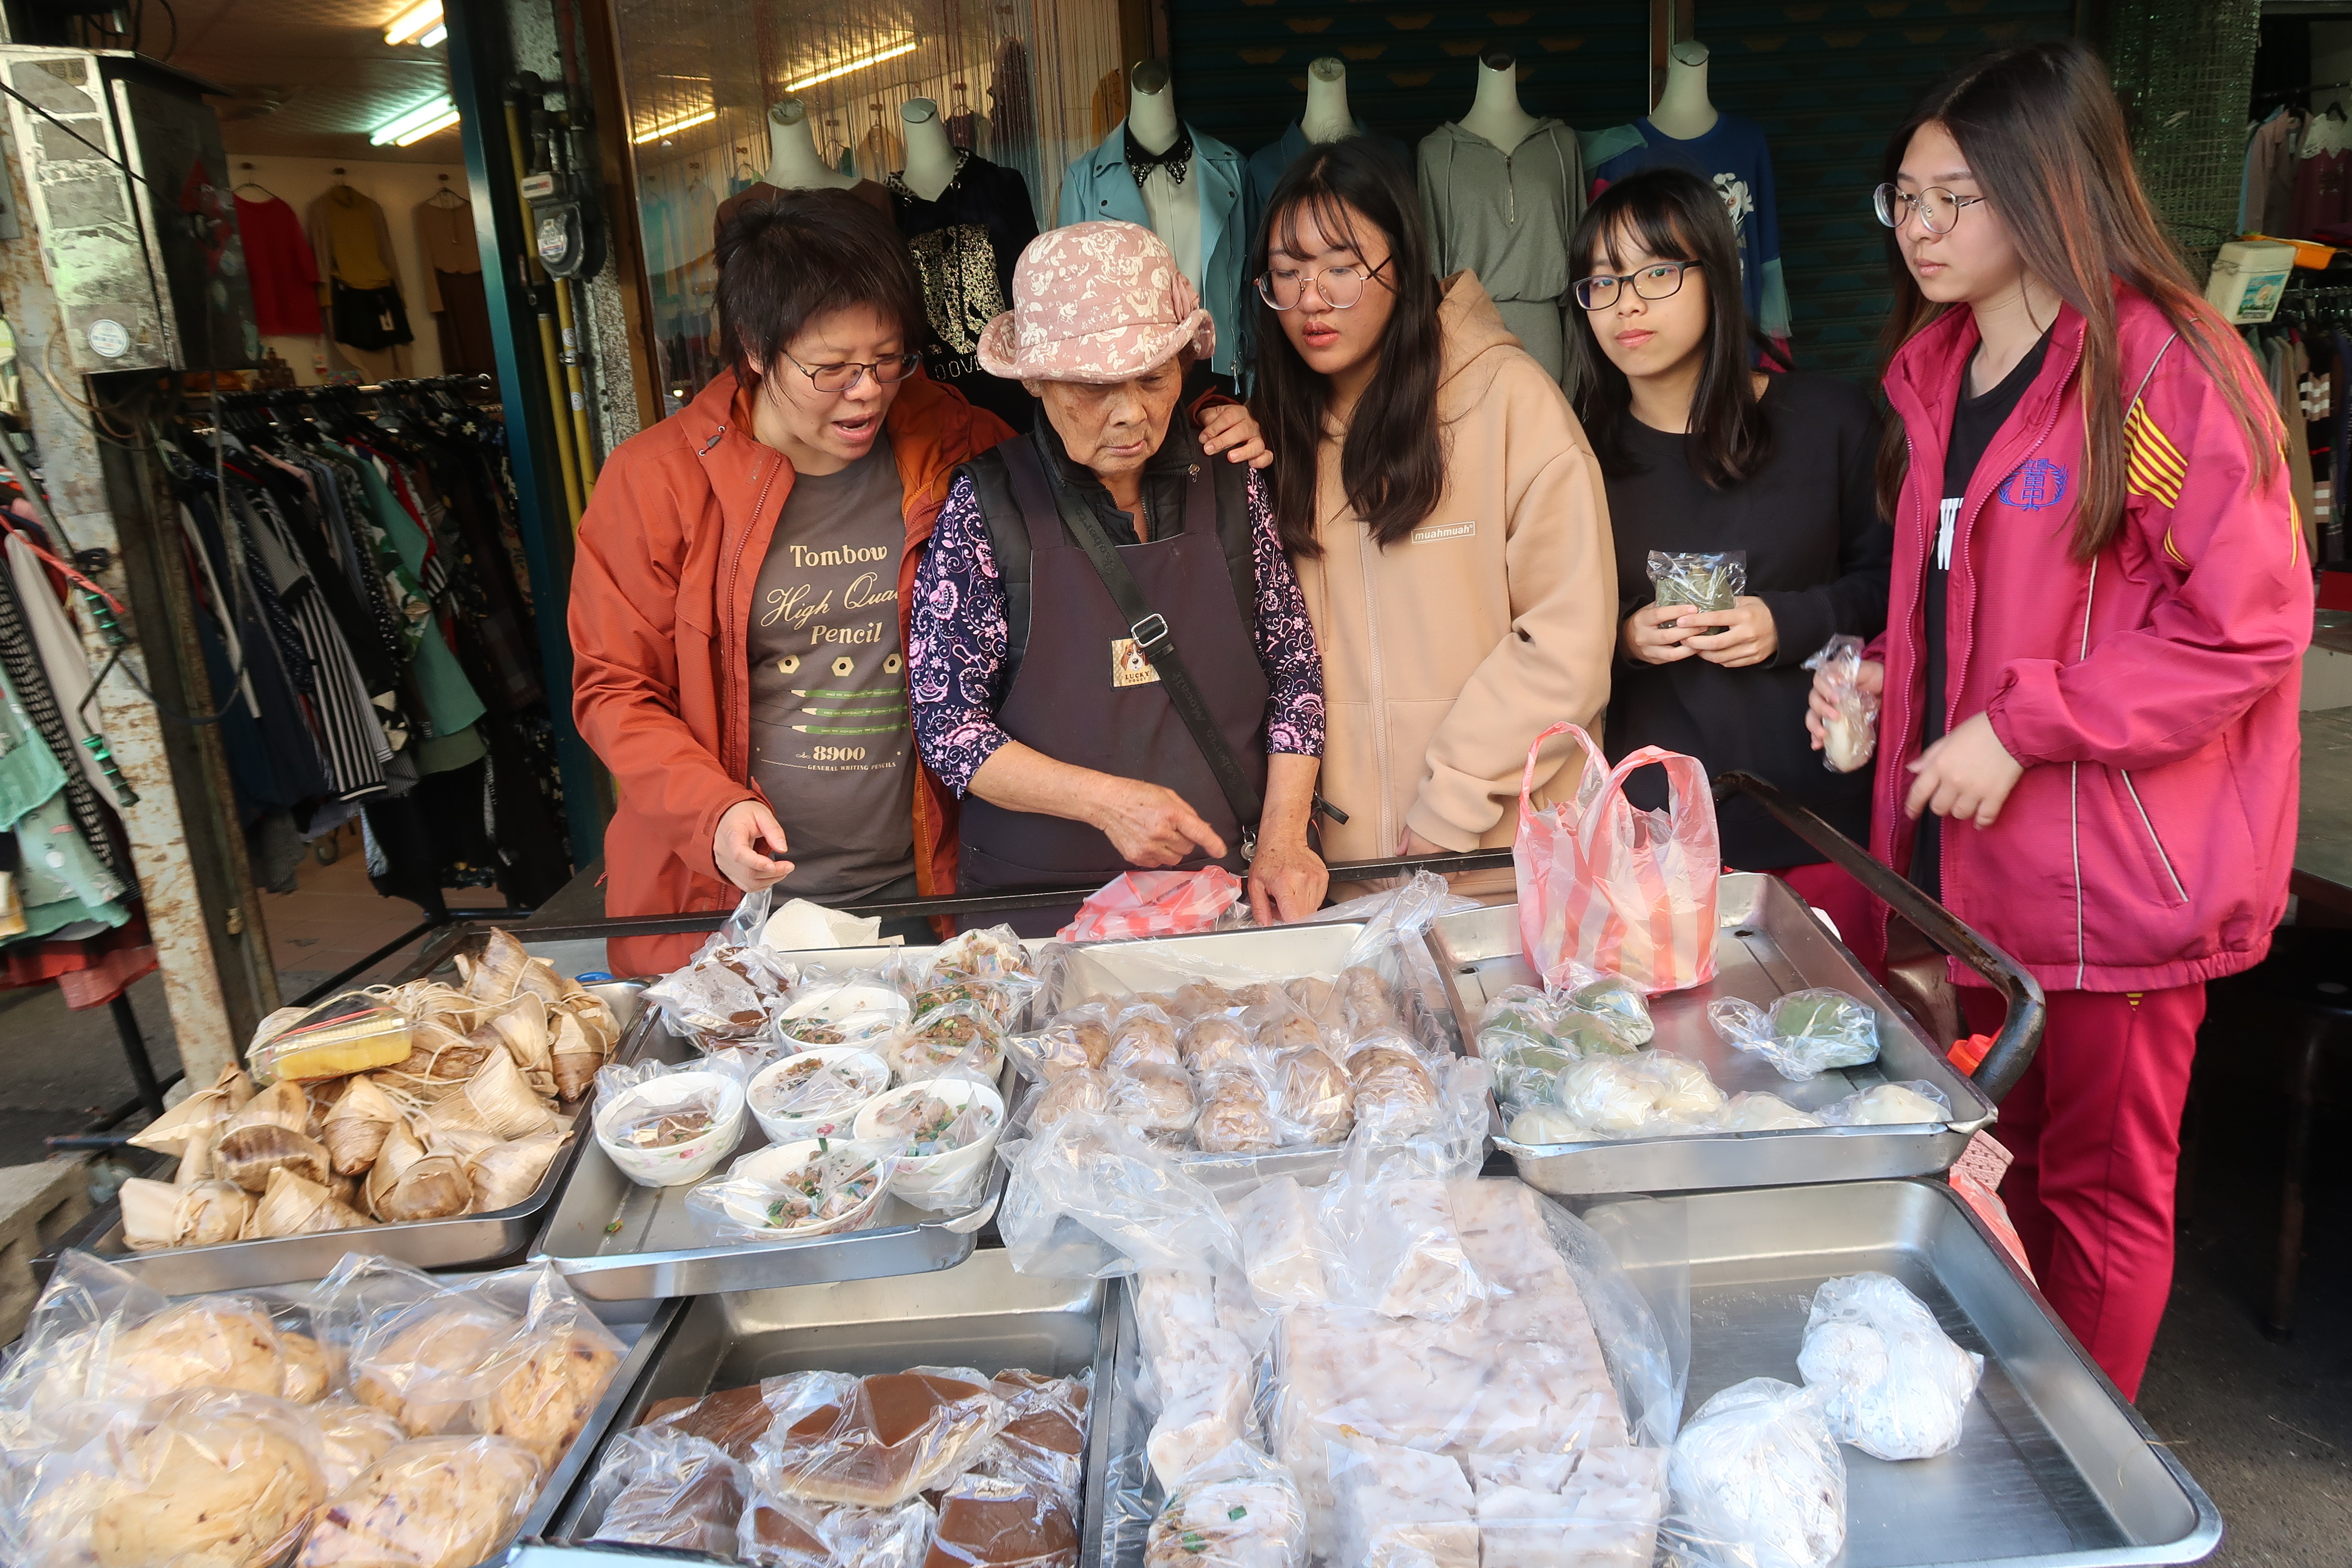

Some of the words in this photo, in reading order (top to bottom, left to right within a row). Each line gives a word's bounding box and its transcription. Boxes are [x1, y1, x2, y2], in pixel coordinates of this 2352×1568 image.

[790, 545, 888, 567] Tombow
[760, 584, 833, 630] High
[810, 622, 882, 645] Pencil
[1125, 671, 1150, 680] LUCKY
[813, 746, 866, 761] 8900
